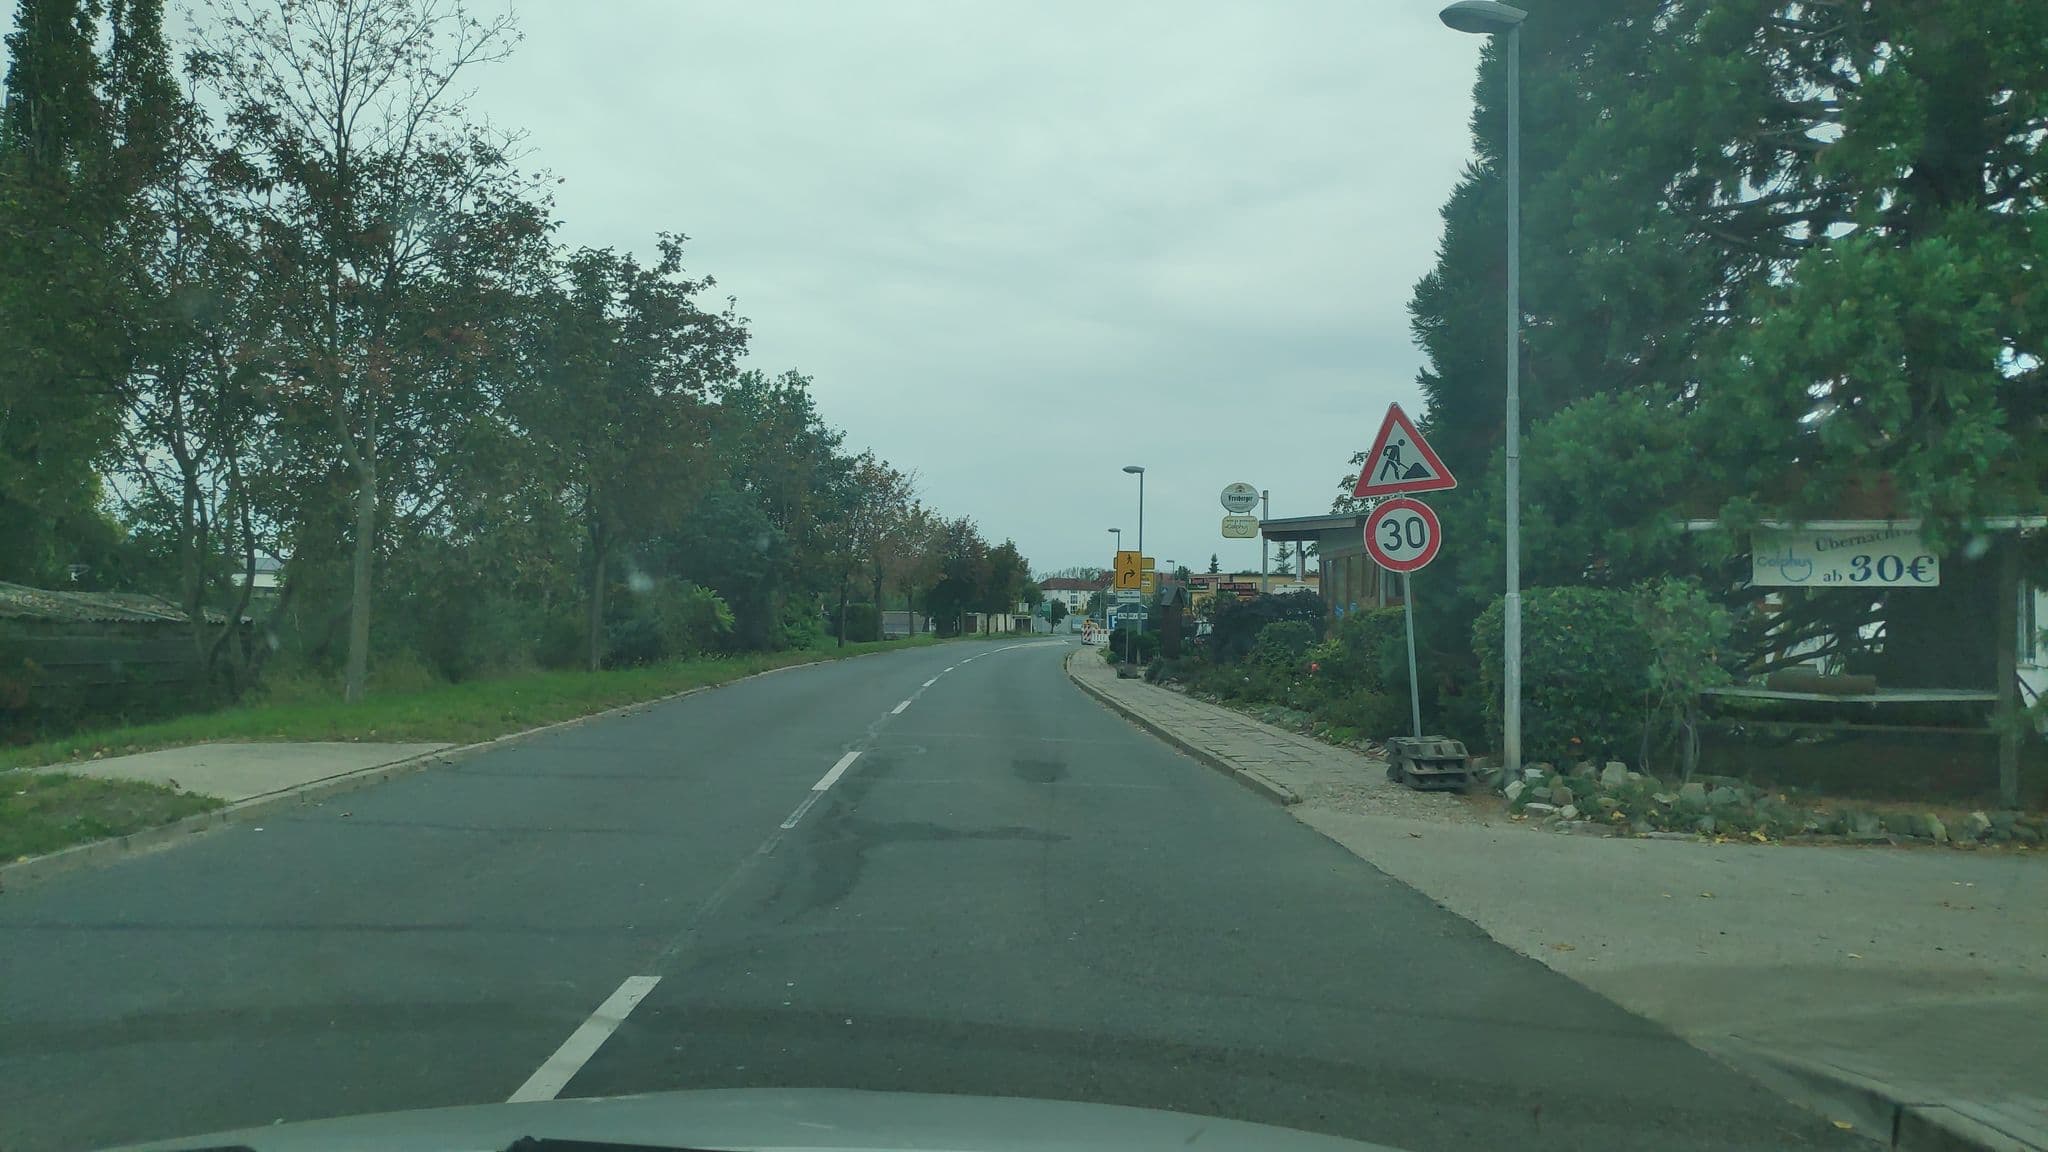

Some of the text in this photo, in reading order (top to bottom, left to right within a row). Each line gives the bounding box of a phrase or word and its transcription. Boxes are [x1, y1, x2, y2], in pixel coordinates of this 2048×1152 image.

[1382, 517, 1426, 551] 30
[1823, 555, 1935, 583] ab 30€
